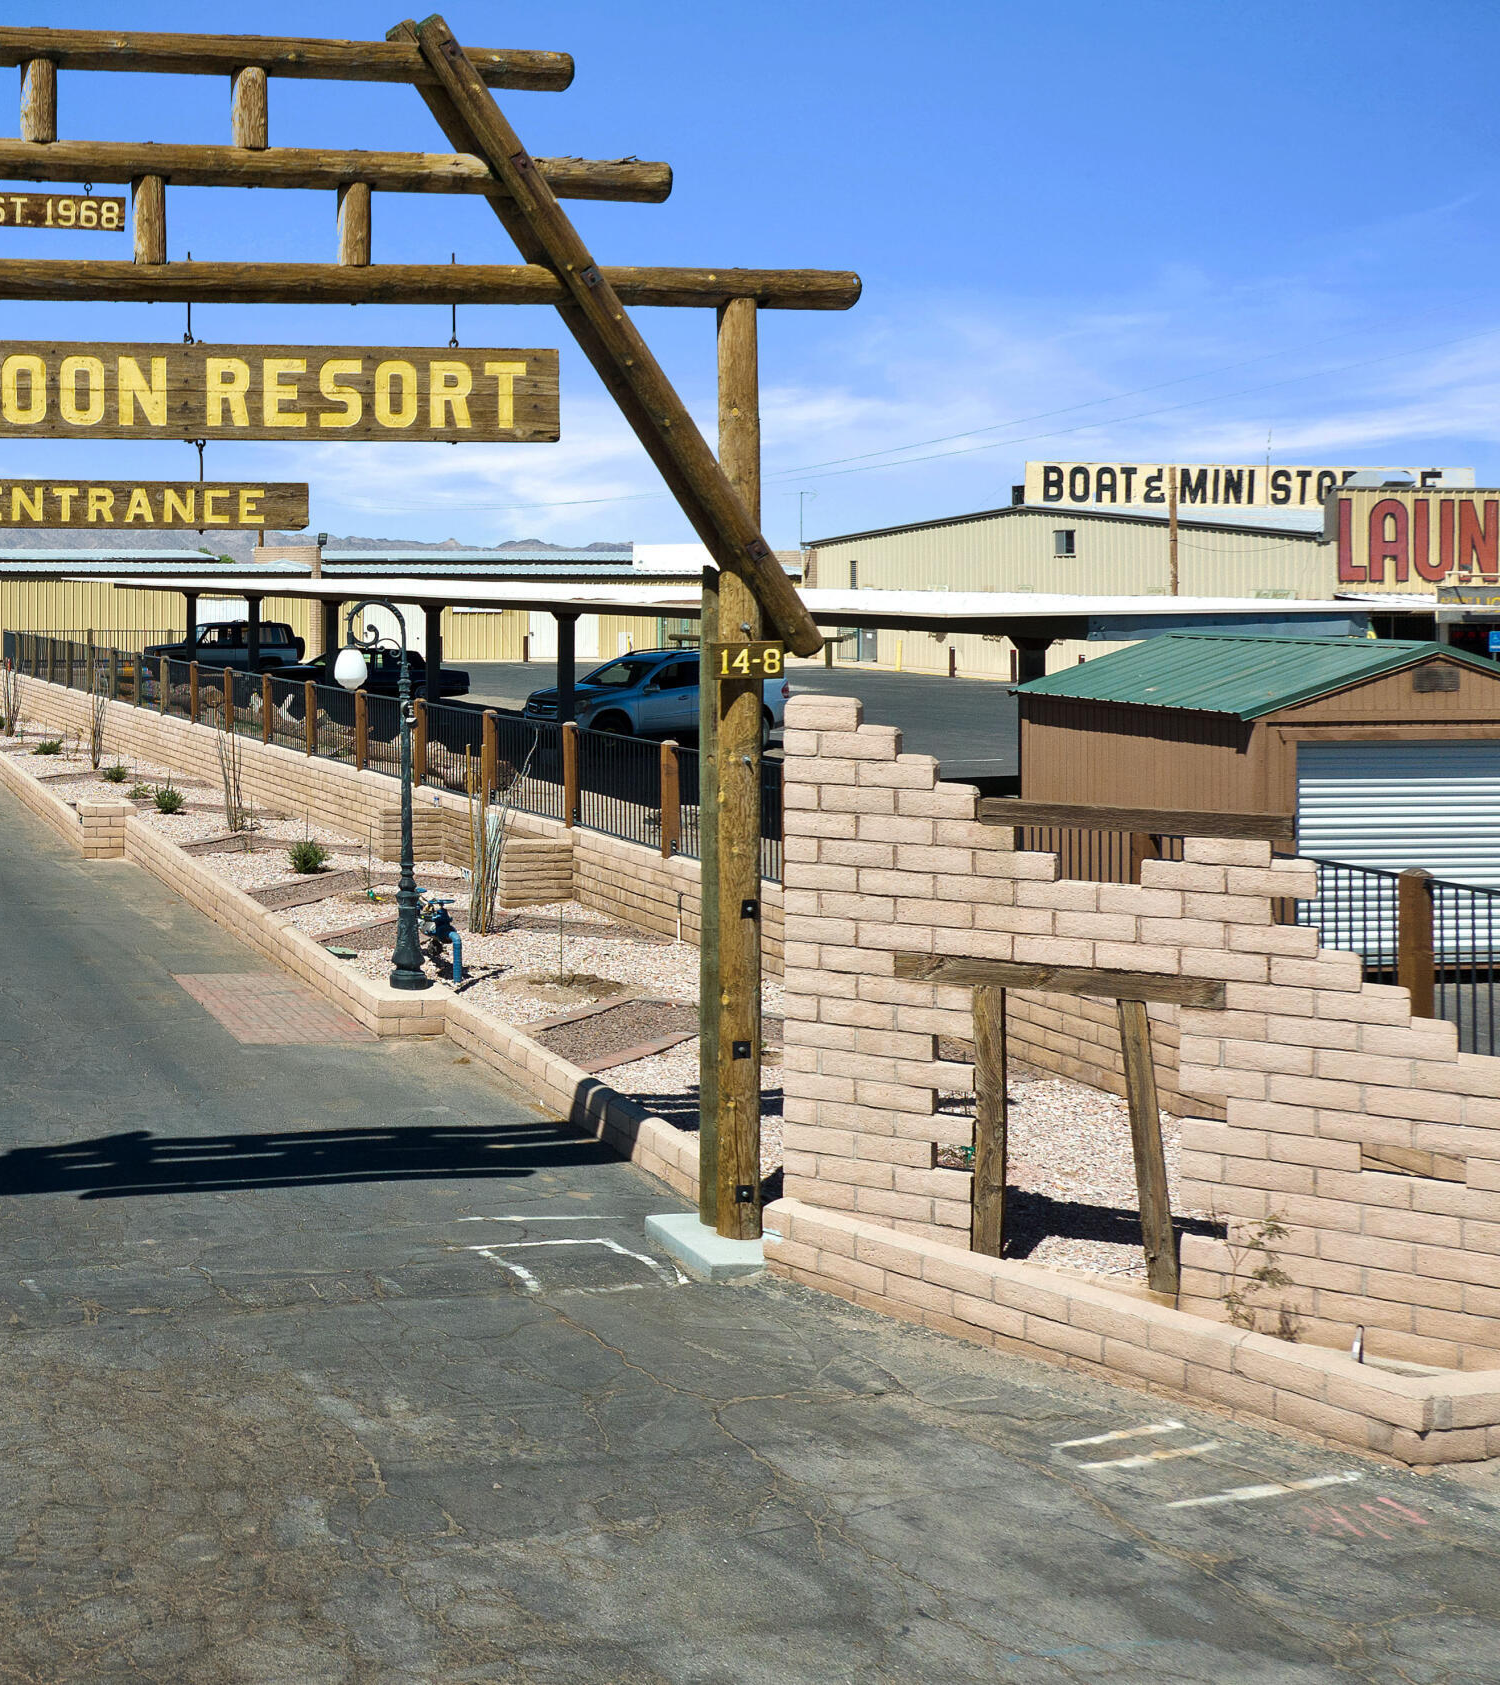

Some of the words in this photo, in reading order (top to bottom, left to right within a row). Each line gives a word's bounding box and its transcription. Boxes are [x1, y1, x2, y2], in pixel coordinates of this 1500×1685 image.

[45, 198, 120, 228] 1968
[206, 357, 527, 429] RESORT
[1180, 468, 1255, 504] MINI
[1338, 498, 1499, 582] LAUN
[720, 648, 780, 675] 14-8
